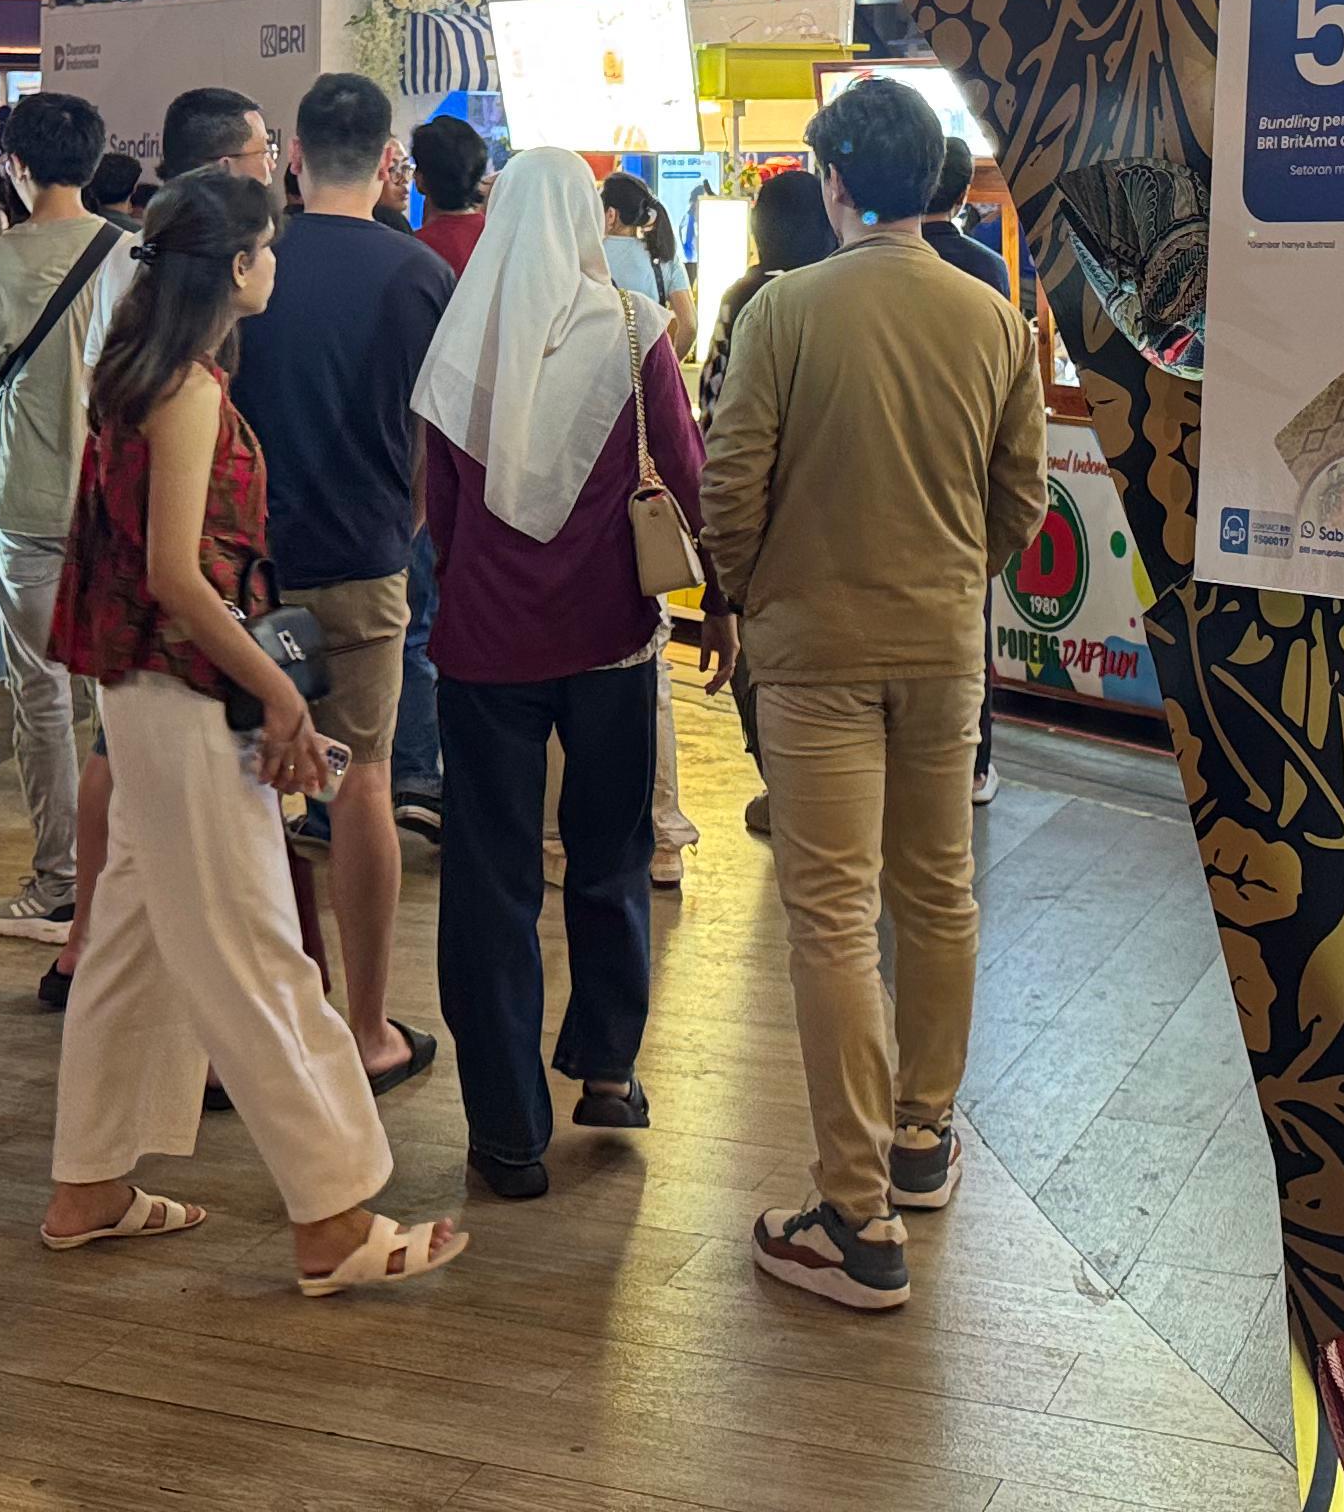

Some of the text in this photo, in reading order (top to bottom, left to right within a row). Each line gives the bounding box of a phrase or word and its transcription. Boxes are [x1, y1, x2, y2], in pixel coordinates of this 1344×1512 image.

[278, 25, 305, 54] BRI
[1259, 114, 1320, 131] Bundling
[1257, 136, 1278, 150] BRI
[1281, 133, 1337, 149] BritAma
[1290, 165, 1332, 176] Setoran
[1029, 596, 1060, 617] 1980
